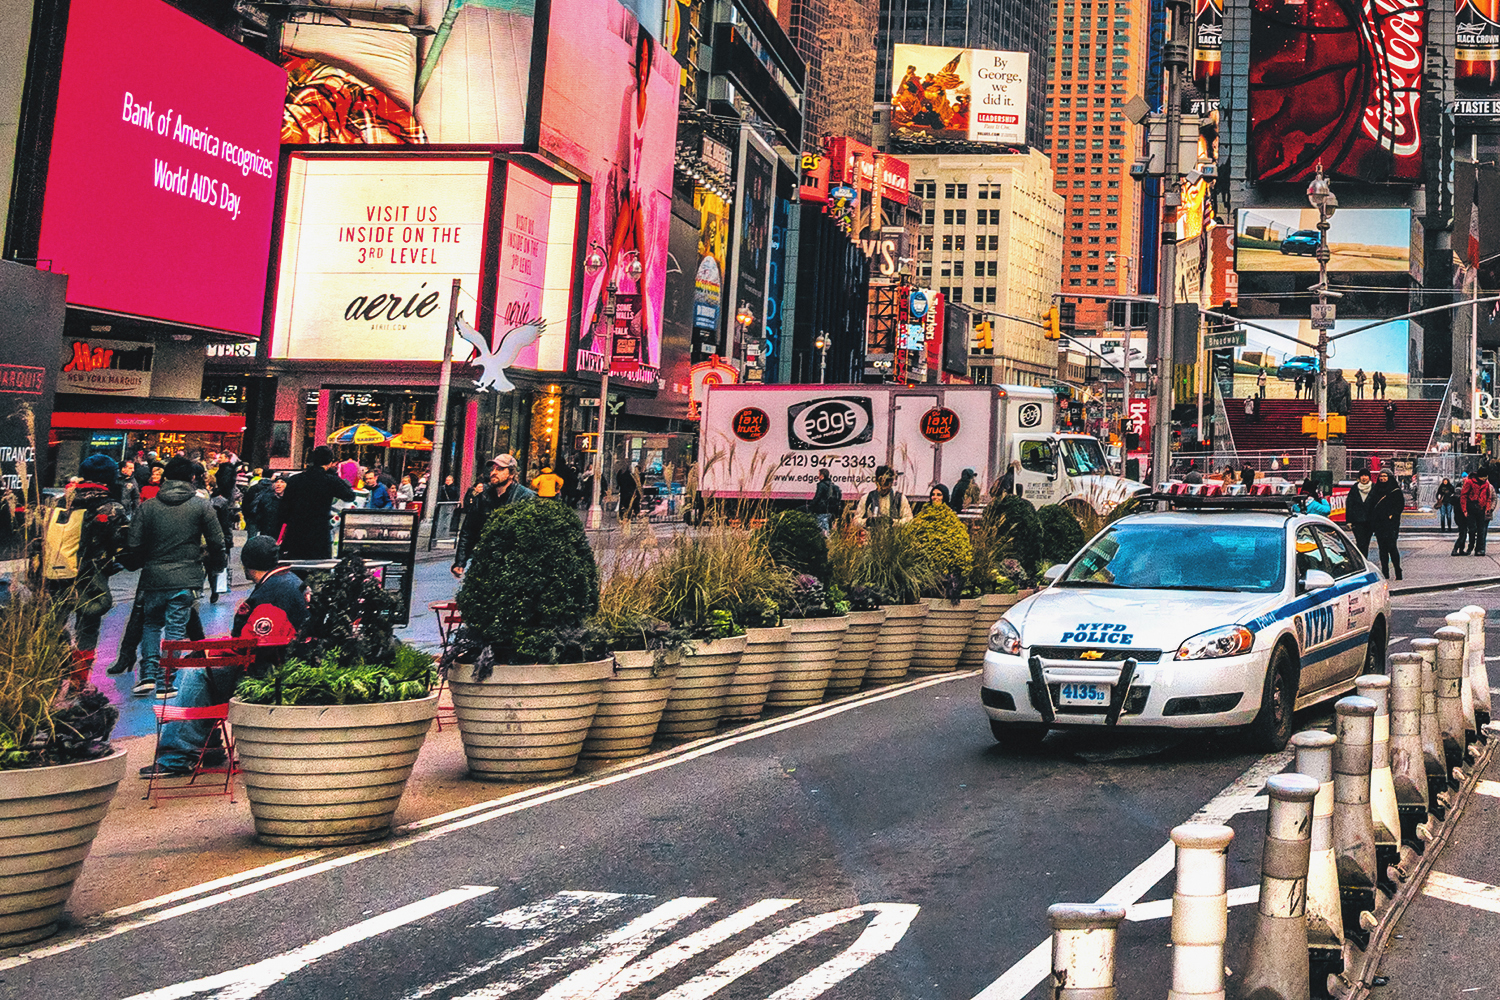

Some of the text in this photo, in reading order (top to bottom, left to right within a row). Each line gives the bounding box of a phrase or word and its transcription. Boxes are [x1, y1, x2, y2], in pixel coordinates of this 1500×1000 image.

[1457, 34, 1499, 44] BLACK CROWN
[994, 56, 1008, 71] By
[978, 67, 1022, 83] George,
[992, 84, 1008, 92] we
[983, 94, 1014, 107] did it.
[979, 114, 1017, 123] LEADERSHIP
[122, 91, 273, 179] Bank of America recognizes
[154, 158, 241, 220] World AIDS Day.
[367, 206, 438, 222] VISIT US
[339, 227, 461, 243] INSIDE ON THE
[358, 247, 437, 264] 3RD LEVEL
[344, 282, 440, 321] aerie
[616, 304, 632, 312] SOME
[616, 312, 634, 320] WALLS
[615, 327, 628, 335] TALK
[1209, 334, 1240, 346] Broadway
[86, 374, 142, 386] YORK MARQUIS
[739, 414, 763, 425] taxi
[805, 409, 857, 436] edge
[927, 415, 952, 425] taxi
[1129, 400, 1146, 437] tkts
[737, 424, 761, 433] truck
[926, 425, 951, 435] truck
[780, 454, 876, 468] (212) 947-3343
[1076, 622, 1127, 632] NYPD
[1304, 605, 1334, 648] NYPD
[1060, 632, 1133, 645] POLICE
[1062, 683, 1097, 700] 4135
